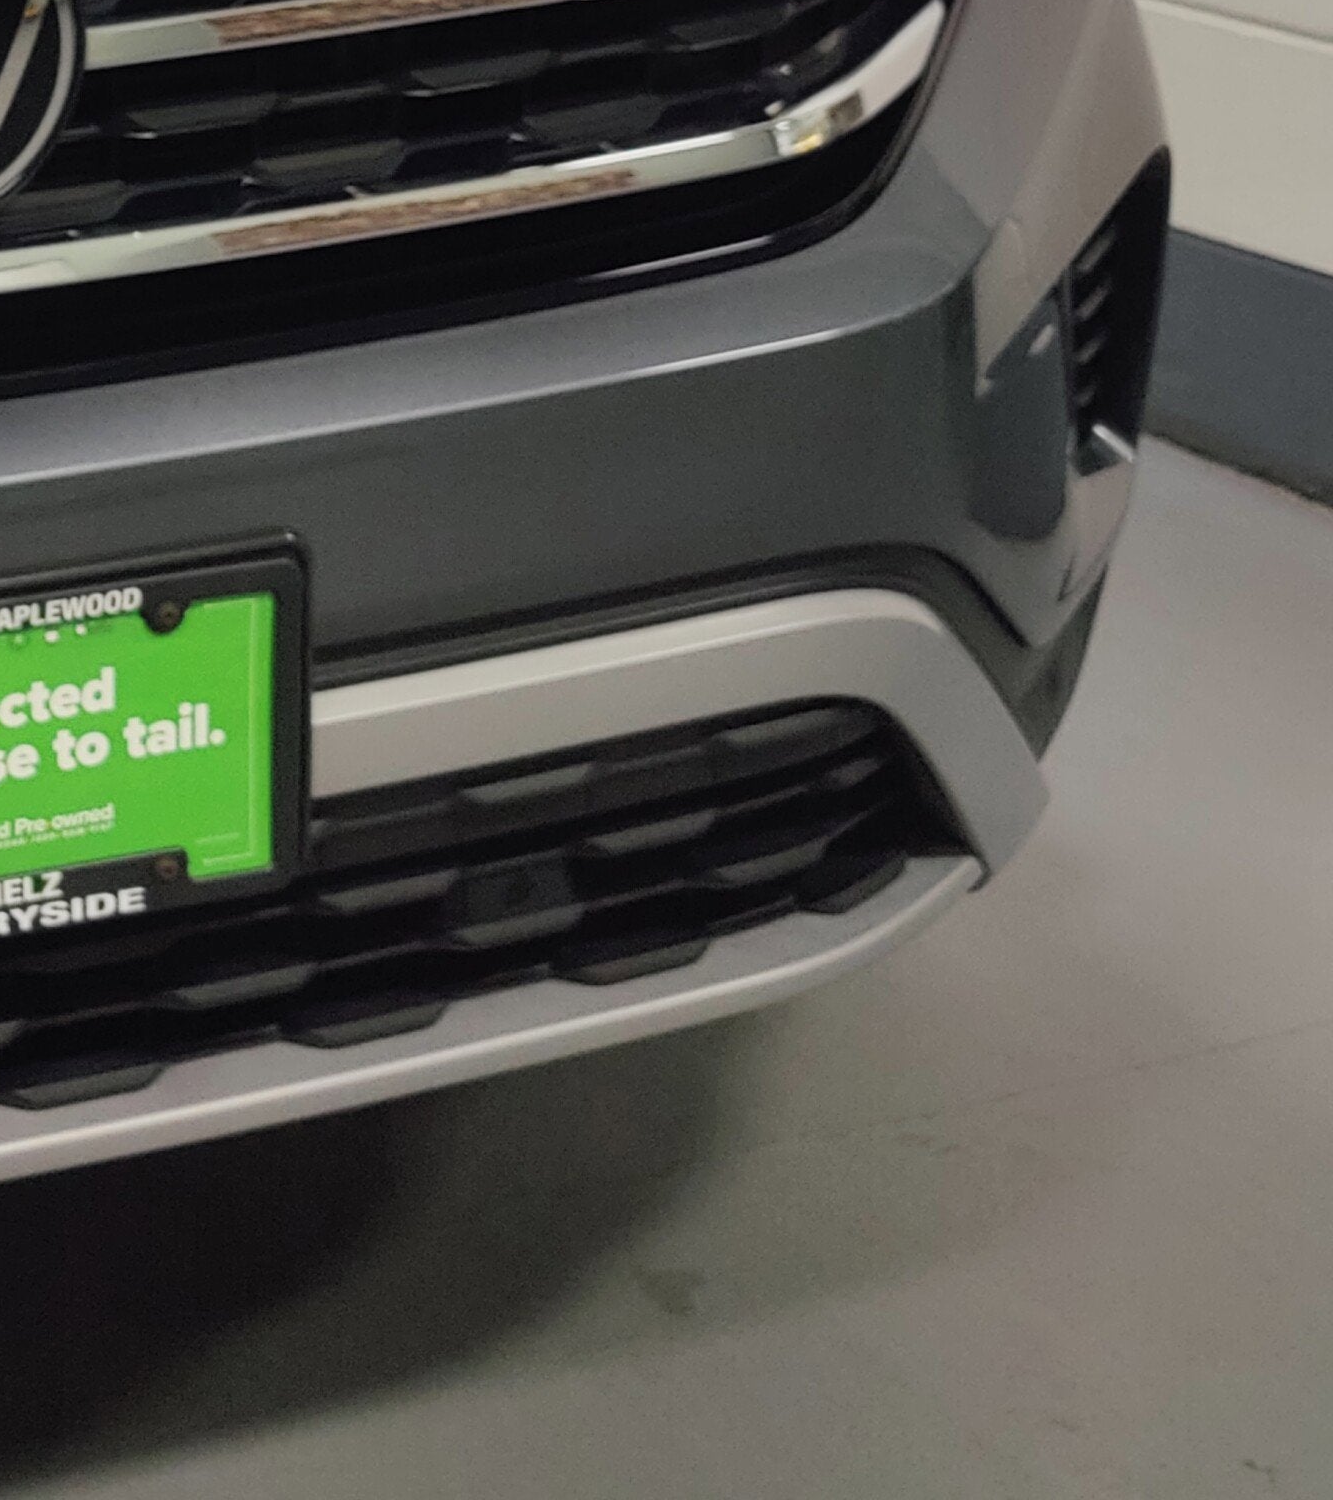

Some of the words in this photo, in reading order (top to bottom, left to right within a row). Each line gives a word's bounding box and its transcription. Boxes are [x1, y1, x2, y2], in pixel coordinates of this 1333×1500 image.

[53, 726, 110, 771] to
[123, 703, 226, 759] tail.
[14, 802, 116, 832] Pre-owned
